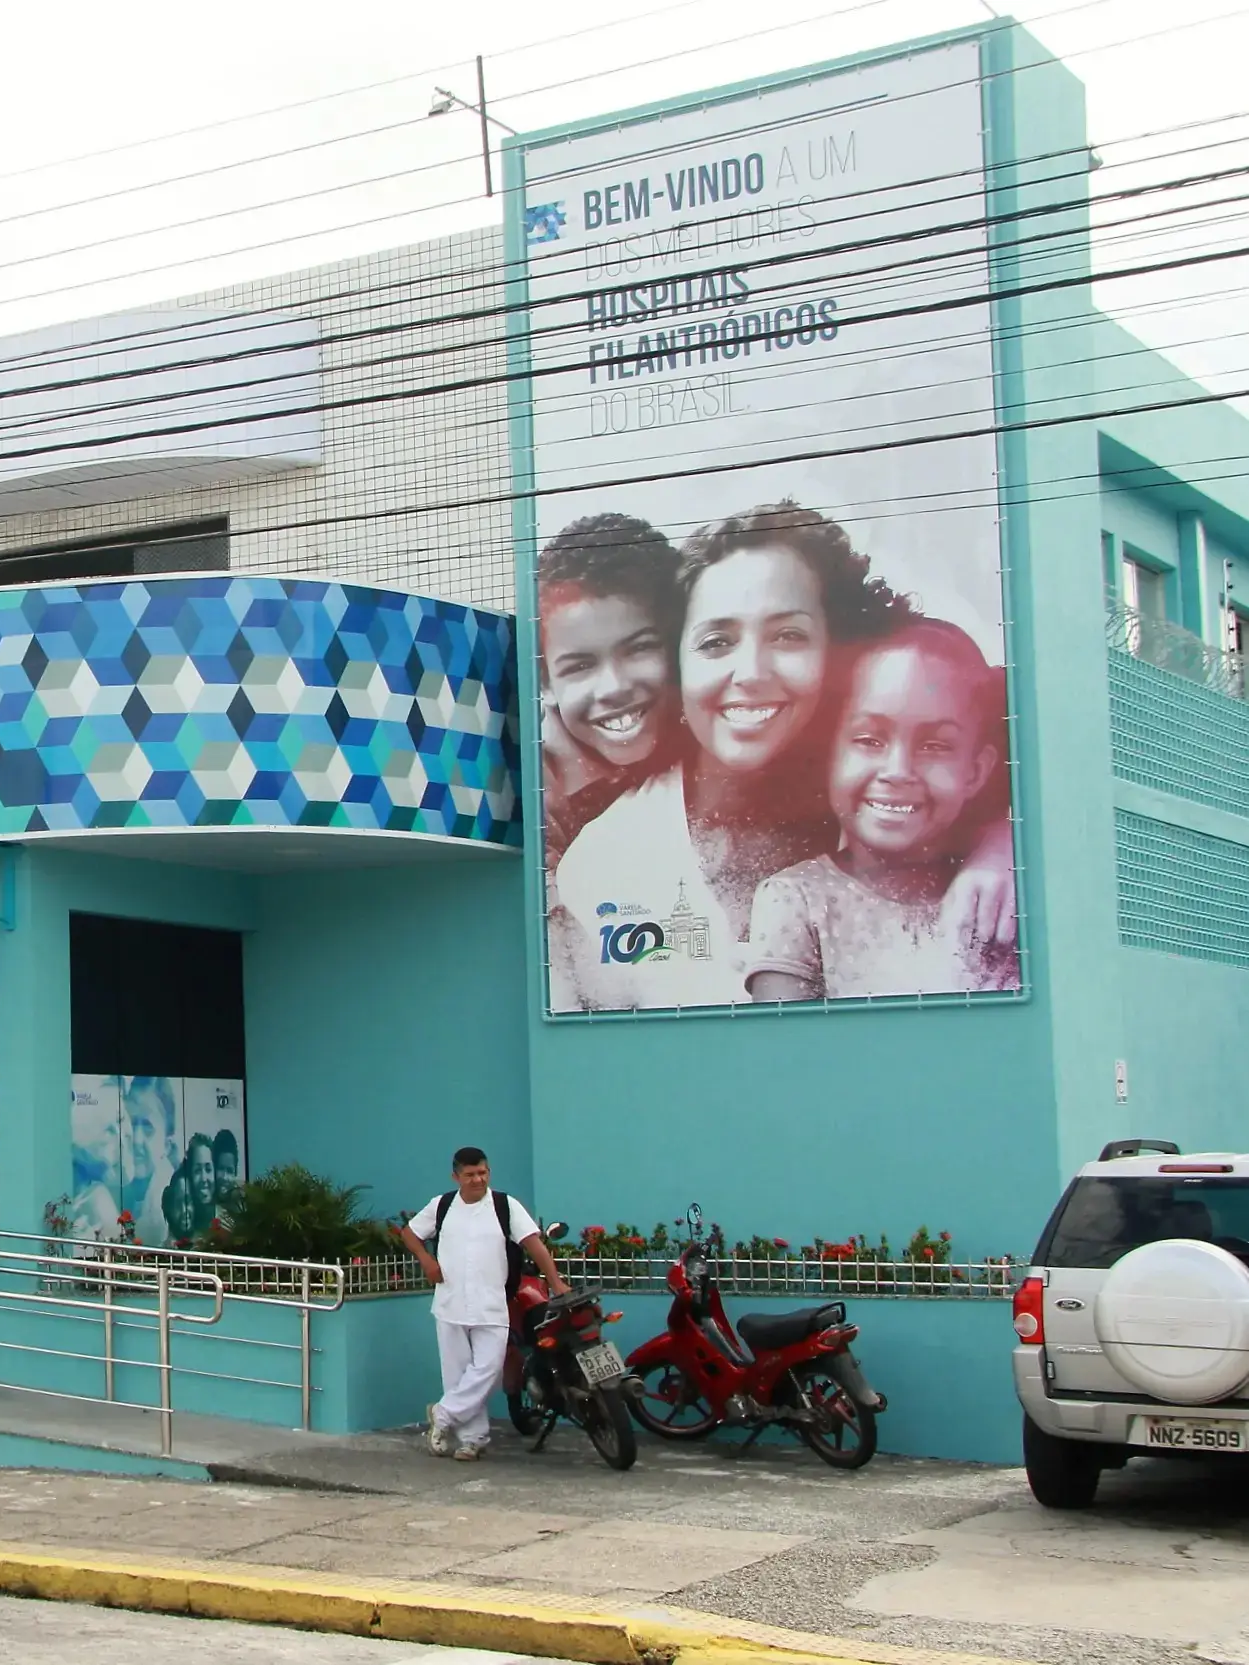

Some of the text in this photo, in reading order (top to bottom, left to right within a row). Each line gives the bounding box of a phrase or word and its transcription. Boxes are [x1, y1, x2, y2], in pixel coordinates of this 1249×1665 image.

[583, 130, 858, 231] BEM-VINDO A UM
[585, 193, 817, 282] DOS MELHORES
[586, 268, 750, 333] HOSPITAIS
[588, 298, 840, 385] FILANTRÓPICOS
[590, 391, 628, 437] DO
